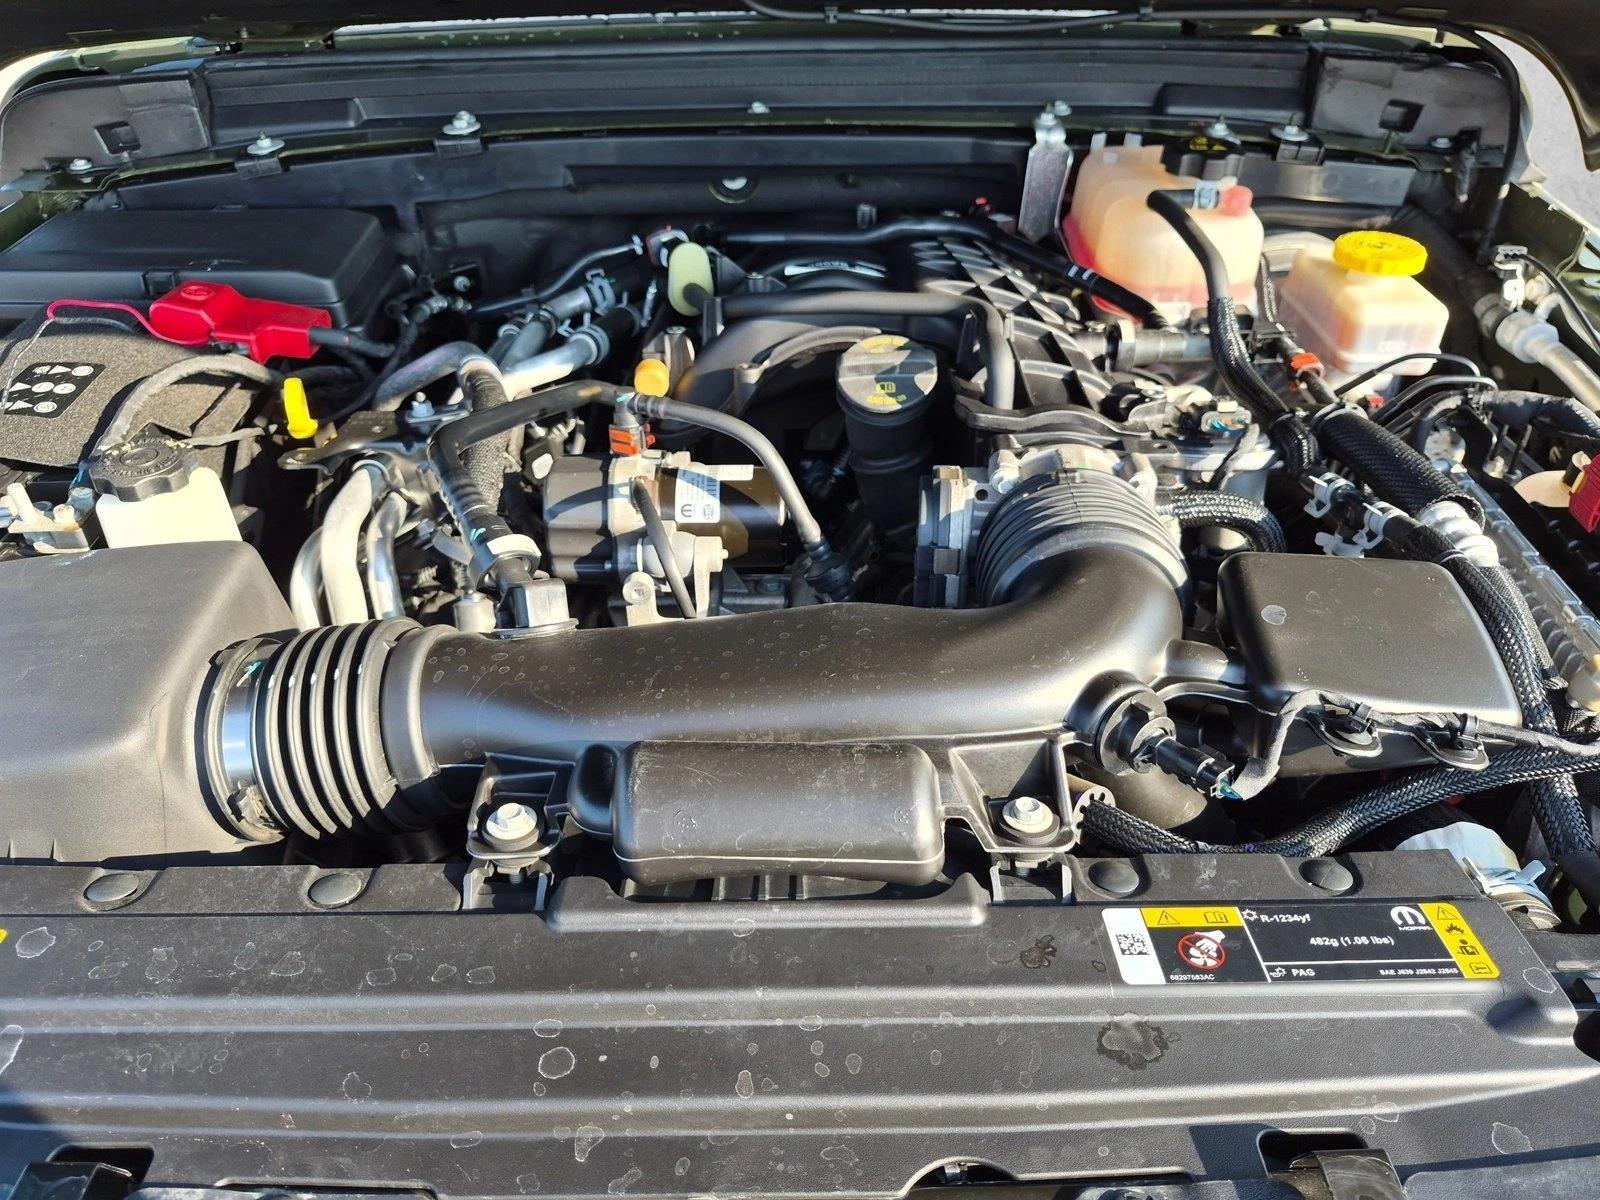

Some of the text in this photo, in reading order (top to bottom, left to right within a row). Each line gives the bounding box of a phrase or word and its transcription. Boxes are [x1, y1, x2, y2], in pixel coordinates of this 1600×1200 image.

[1260, 913, 1312, 923] R-1234yf
[1309, 935, 1395, 947] 482g (1.06 lbs)
[1291, 968, 1316, 977] PAG
